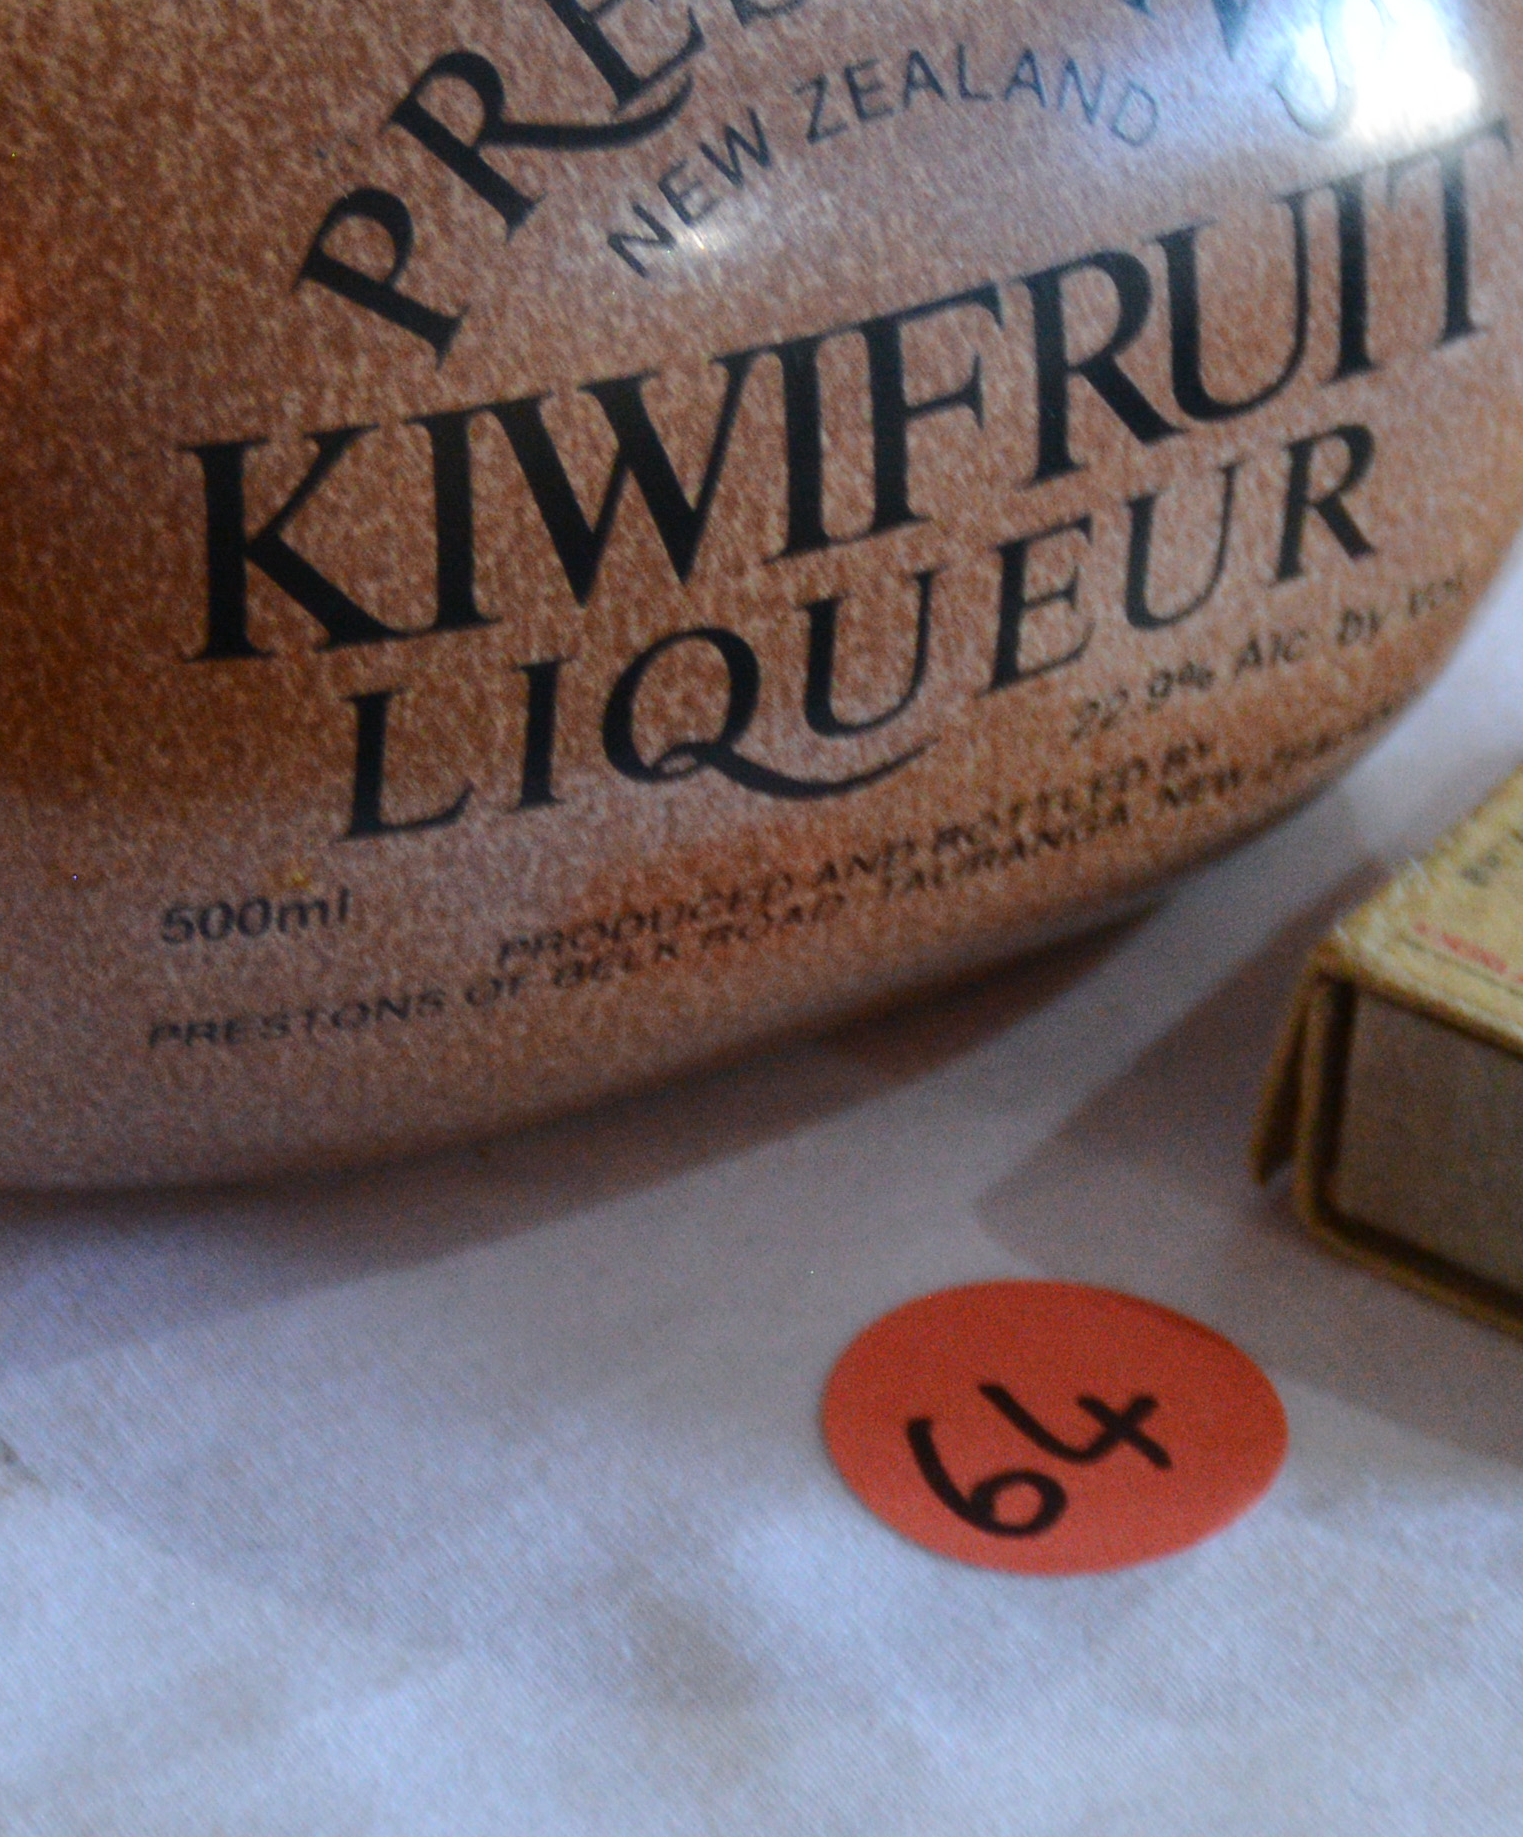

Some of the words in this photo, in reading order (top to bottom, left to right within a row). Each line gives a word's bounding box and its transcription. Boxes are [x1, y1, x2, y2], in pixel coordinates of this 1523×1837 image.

[606, 122, 773, 279] NEW
[804, 44, 1158, 150] ZEALAND
[180, 122, 1509, 664] KIWIFRUIT
[334, 420, 1380, 844] LIQUEUR
[161, 884, 351, 947] 500ml
[498, 872, 794, 966] PRODUCED
[148, 984, 450, 1052] PRESTONS
[464, 974, 525, 1009] OF
[904, 1381, 1174, 1540] 64
